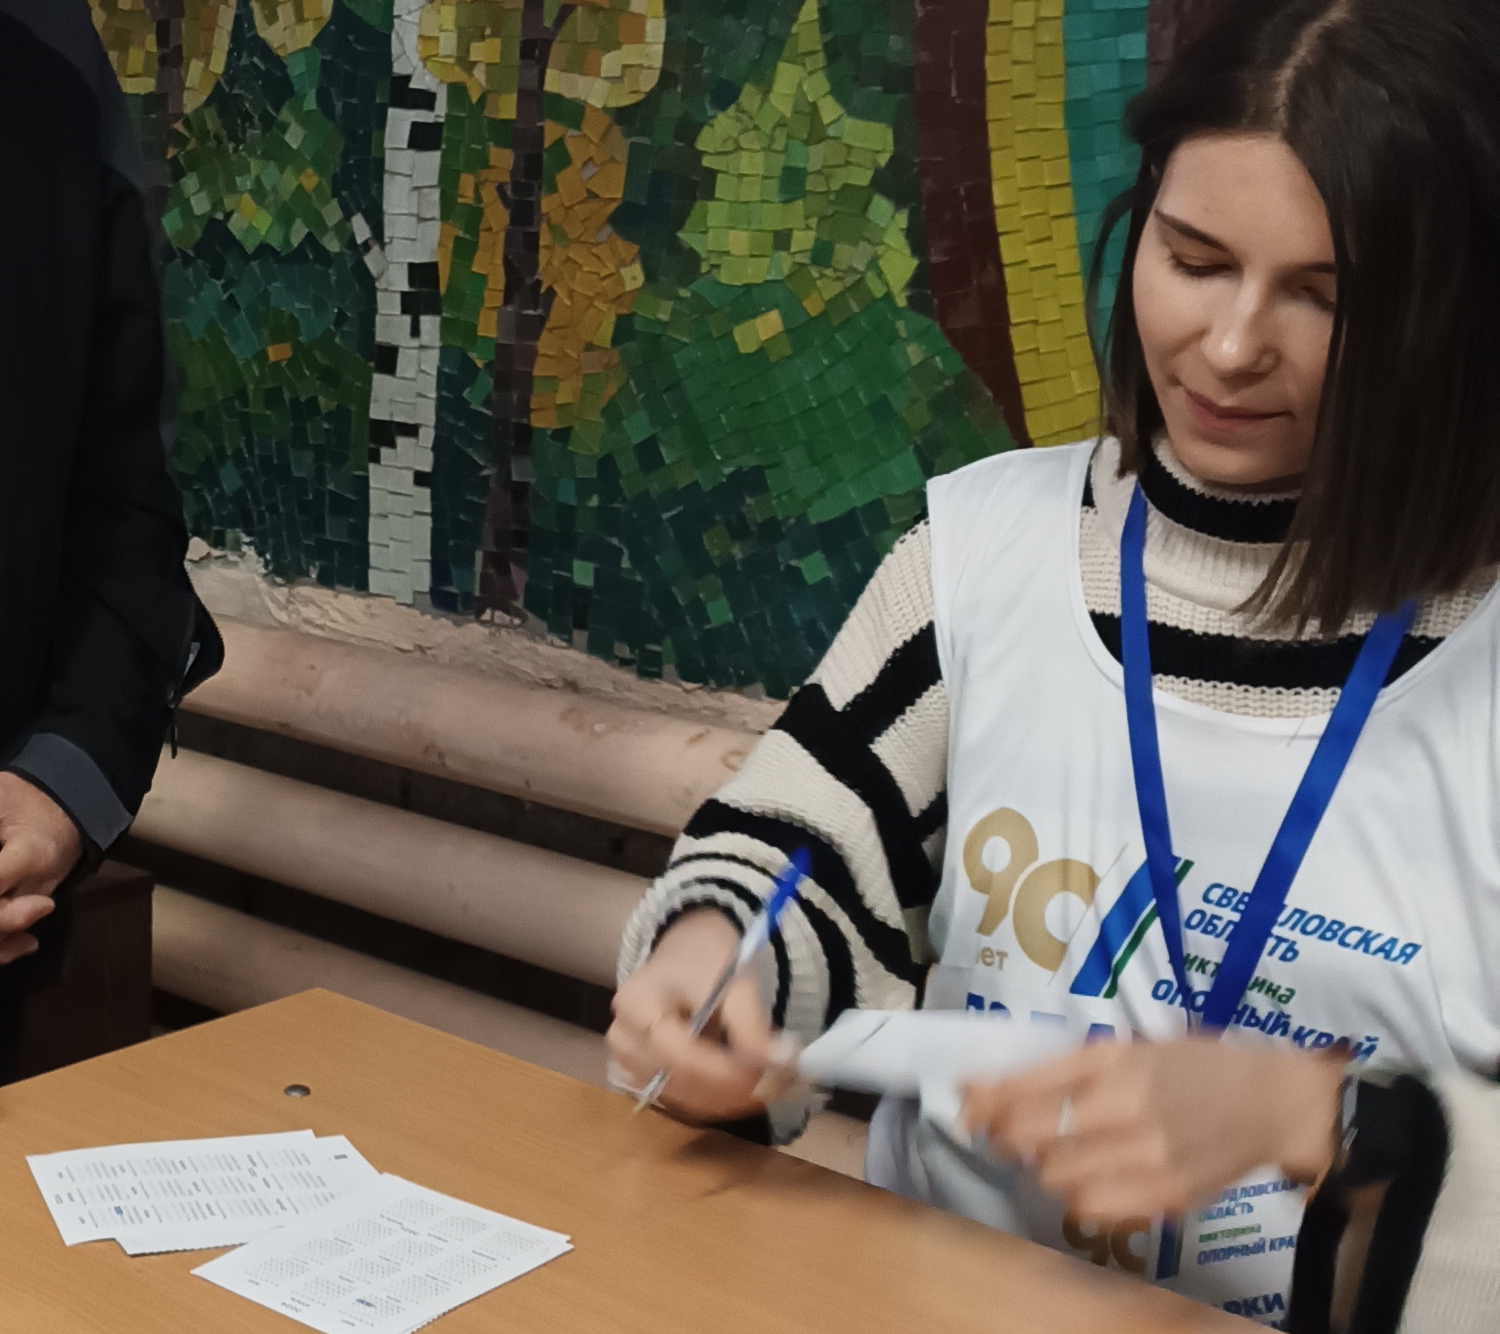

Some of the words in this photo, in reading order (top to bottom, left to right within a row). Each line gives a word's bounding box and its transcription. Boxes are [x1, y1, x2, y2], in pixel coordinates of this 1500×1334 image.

[1185, 908, 1300, 963] ОБЛТЬ
[1202, 882, 1422, 965] СВЕЛОВСКАЯ
[975, 946, 1008, 971] ет
[1169, 952, 1296, 1004] иктина
[1269, 1235, 1295, 1253] КРА
